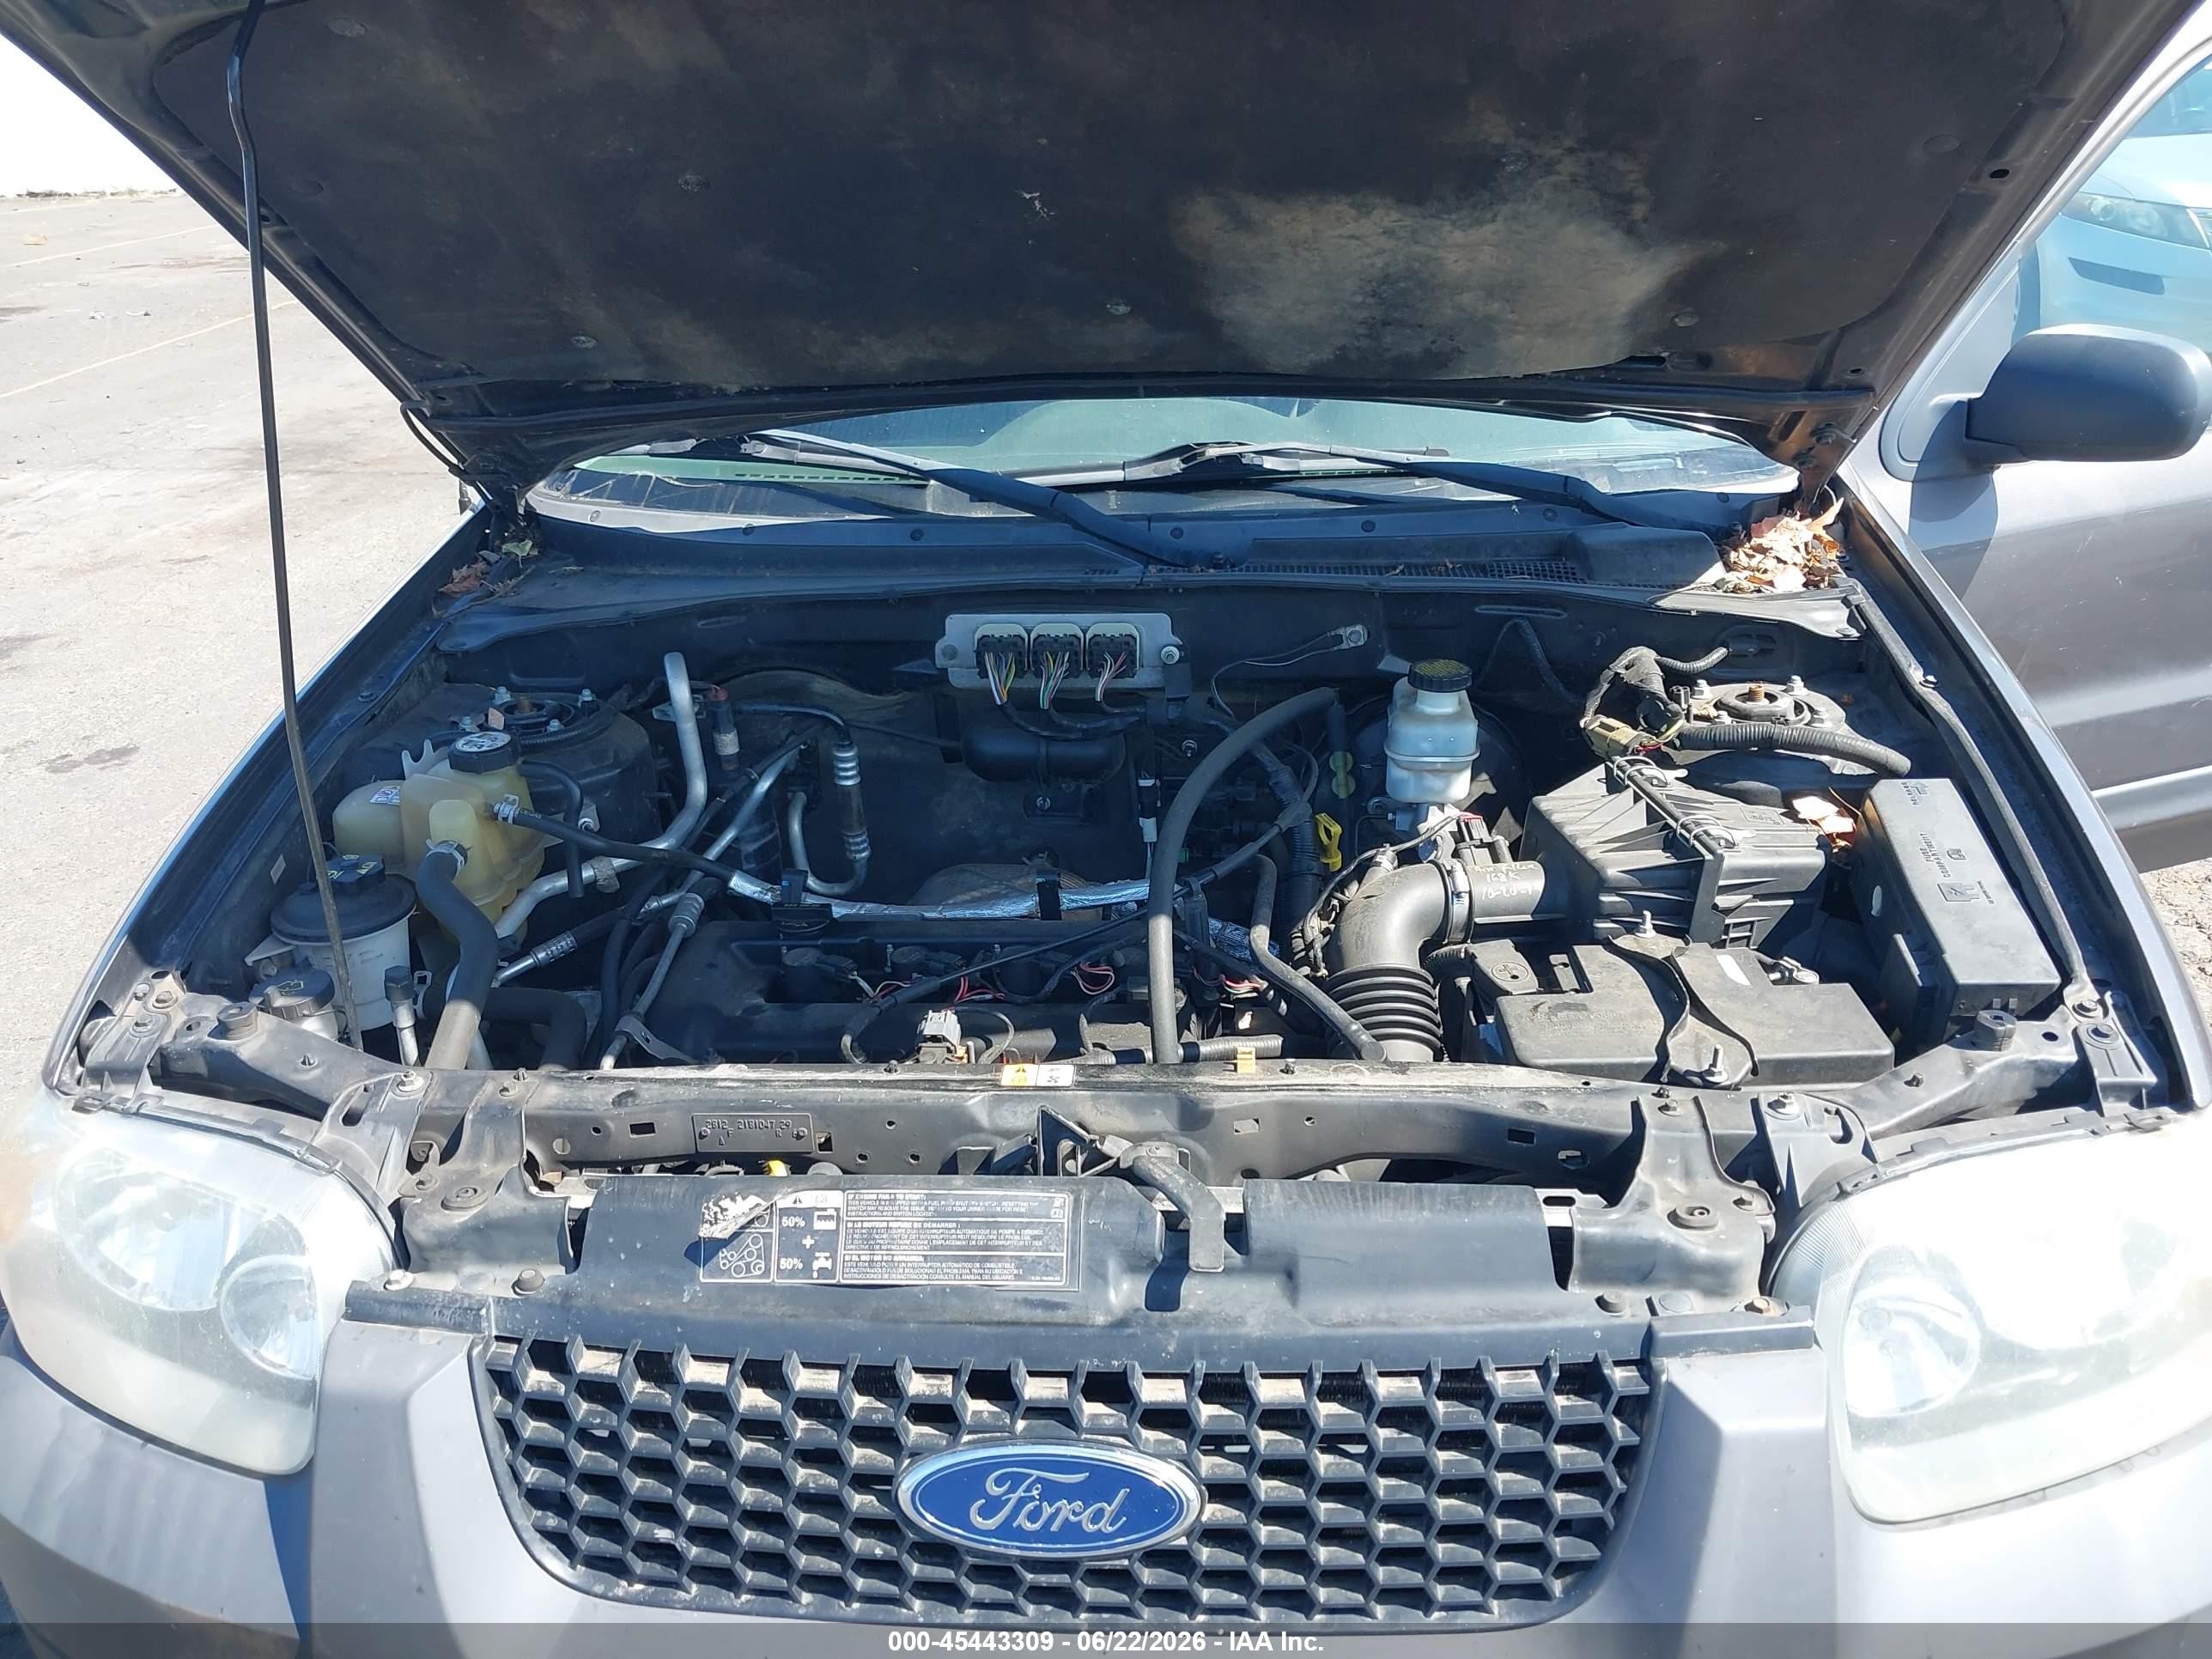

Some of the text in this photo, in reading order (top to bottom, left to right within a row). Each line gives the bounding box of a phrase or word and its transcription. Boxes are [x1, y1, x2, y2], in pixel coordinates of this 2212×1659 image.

[1919, 832, 1952, 878] COMPARTMENT
[781, 1216, 805, 1227] 50%
[780, 1257, 803, 1270] 50%
[969, 1467, 1133, 1534] Ford
